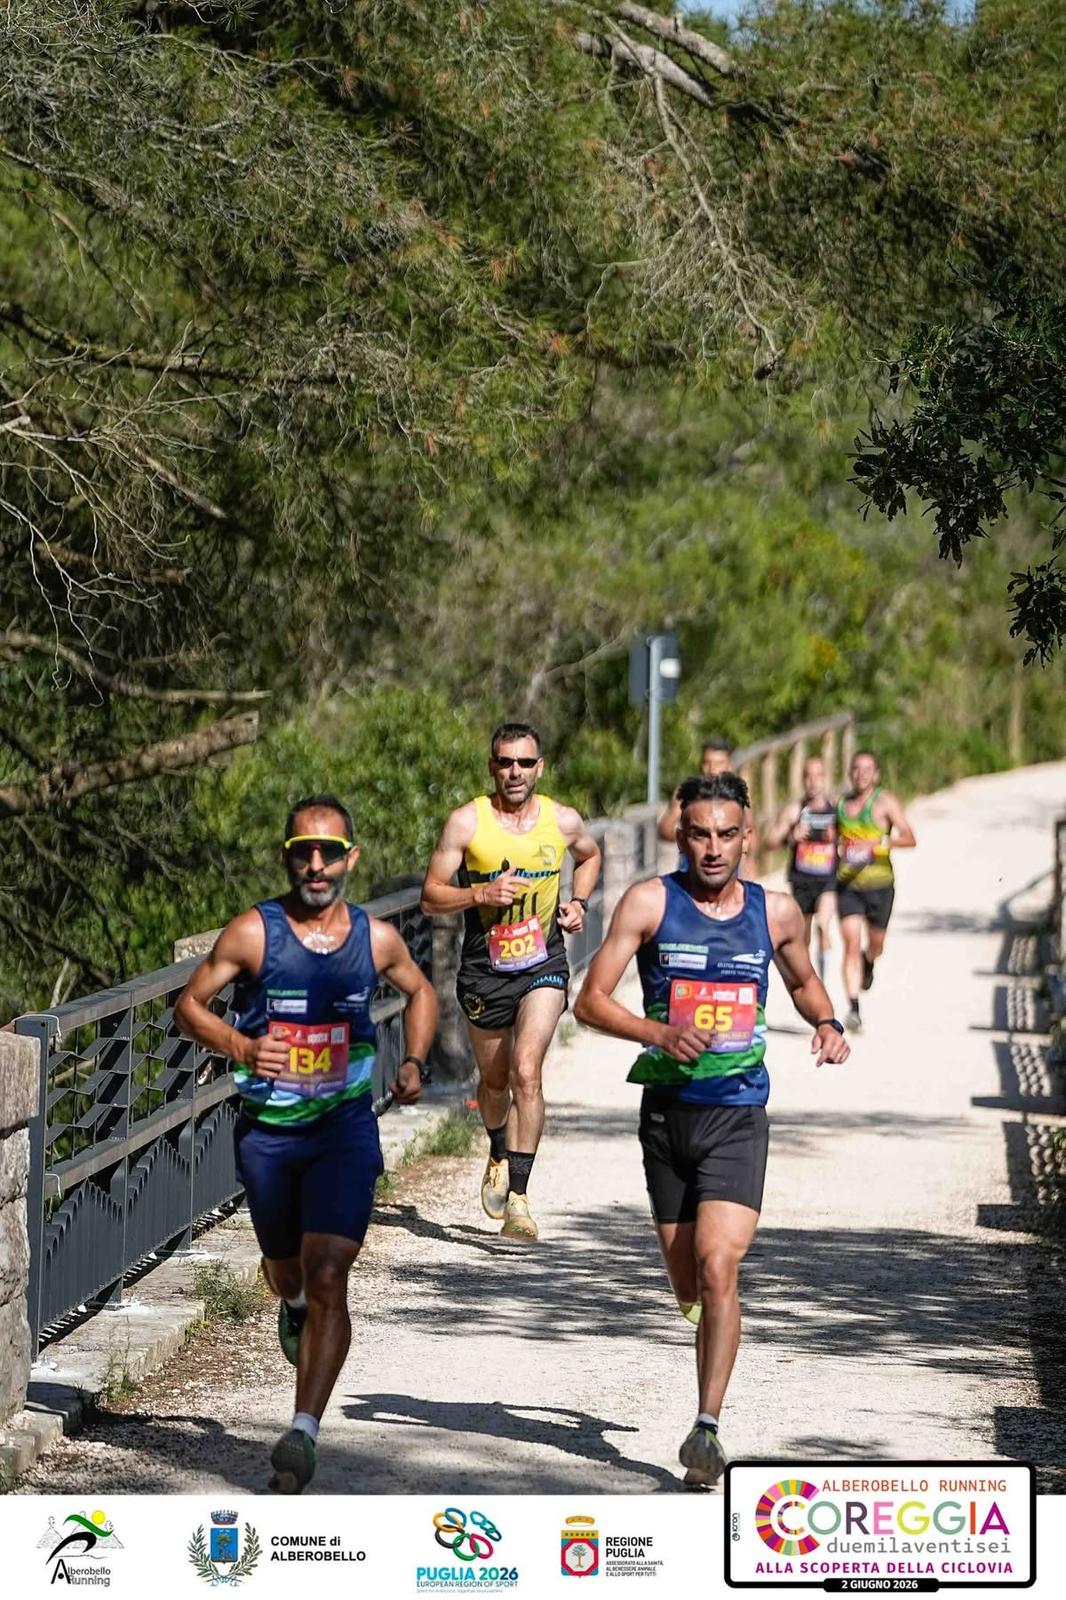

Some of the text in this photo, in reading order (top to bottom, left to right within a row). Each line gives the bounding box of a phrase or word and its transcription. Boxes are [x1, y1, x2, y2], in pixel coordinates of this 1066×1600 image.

[499, 934, 536, 958] 202
[694, 1004, 733, 1031] 65
[289, 1046, 332, 1073] 134
